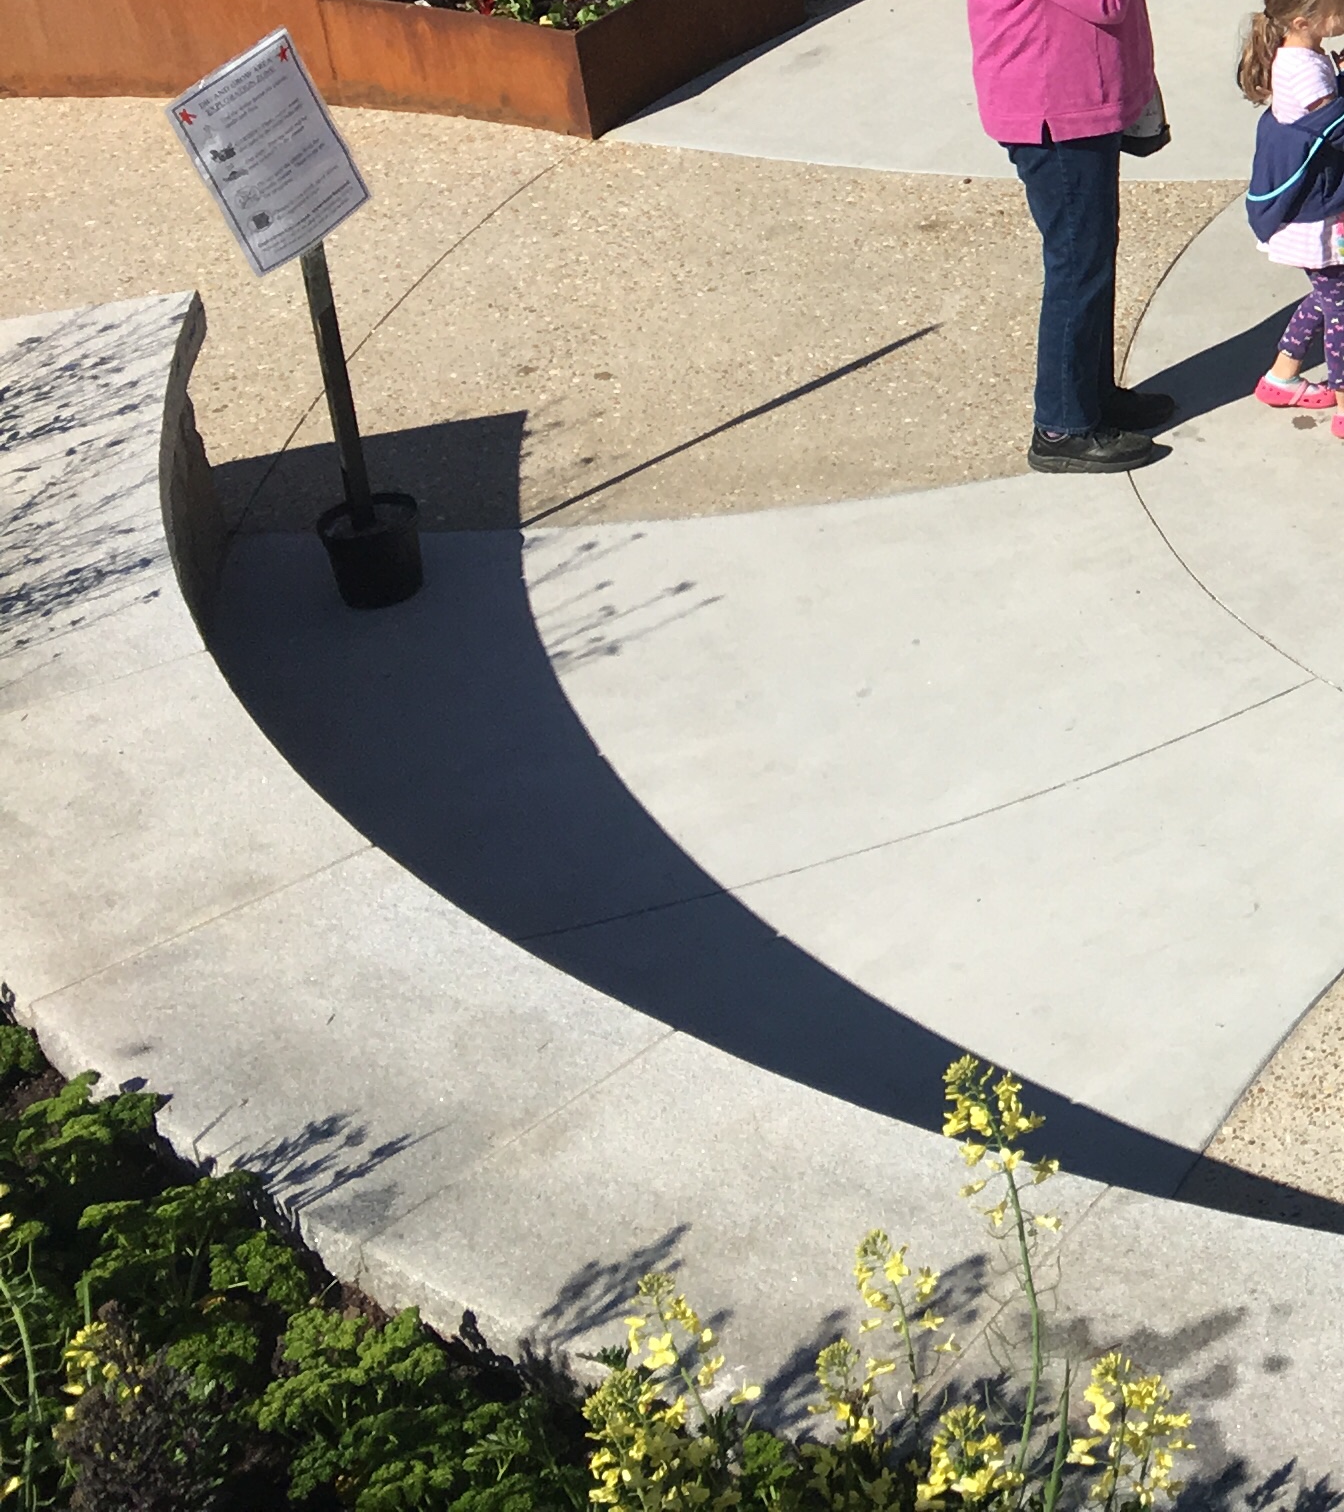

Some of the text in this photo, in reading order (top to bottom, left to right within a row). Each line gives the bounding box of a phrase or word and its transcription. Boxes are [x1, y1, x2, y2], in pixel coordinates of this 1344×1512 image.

[214, 85, 230, 99] AND
[230, 71, 252, 89] GROW
[253, 58, 273, 72] AREA
[205, 80, 256, 116] EXPLORATION
